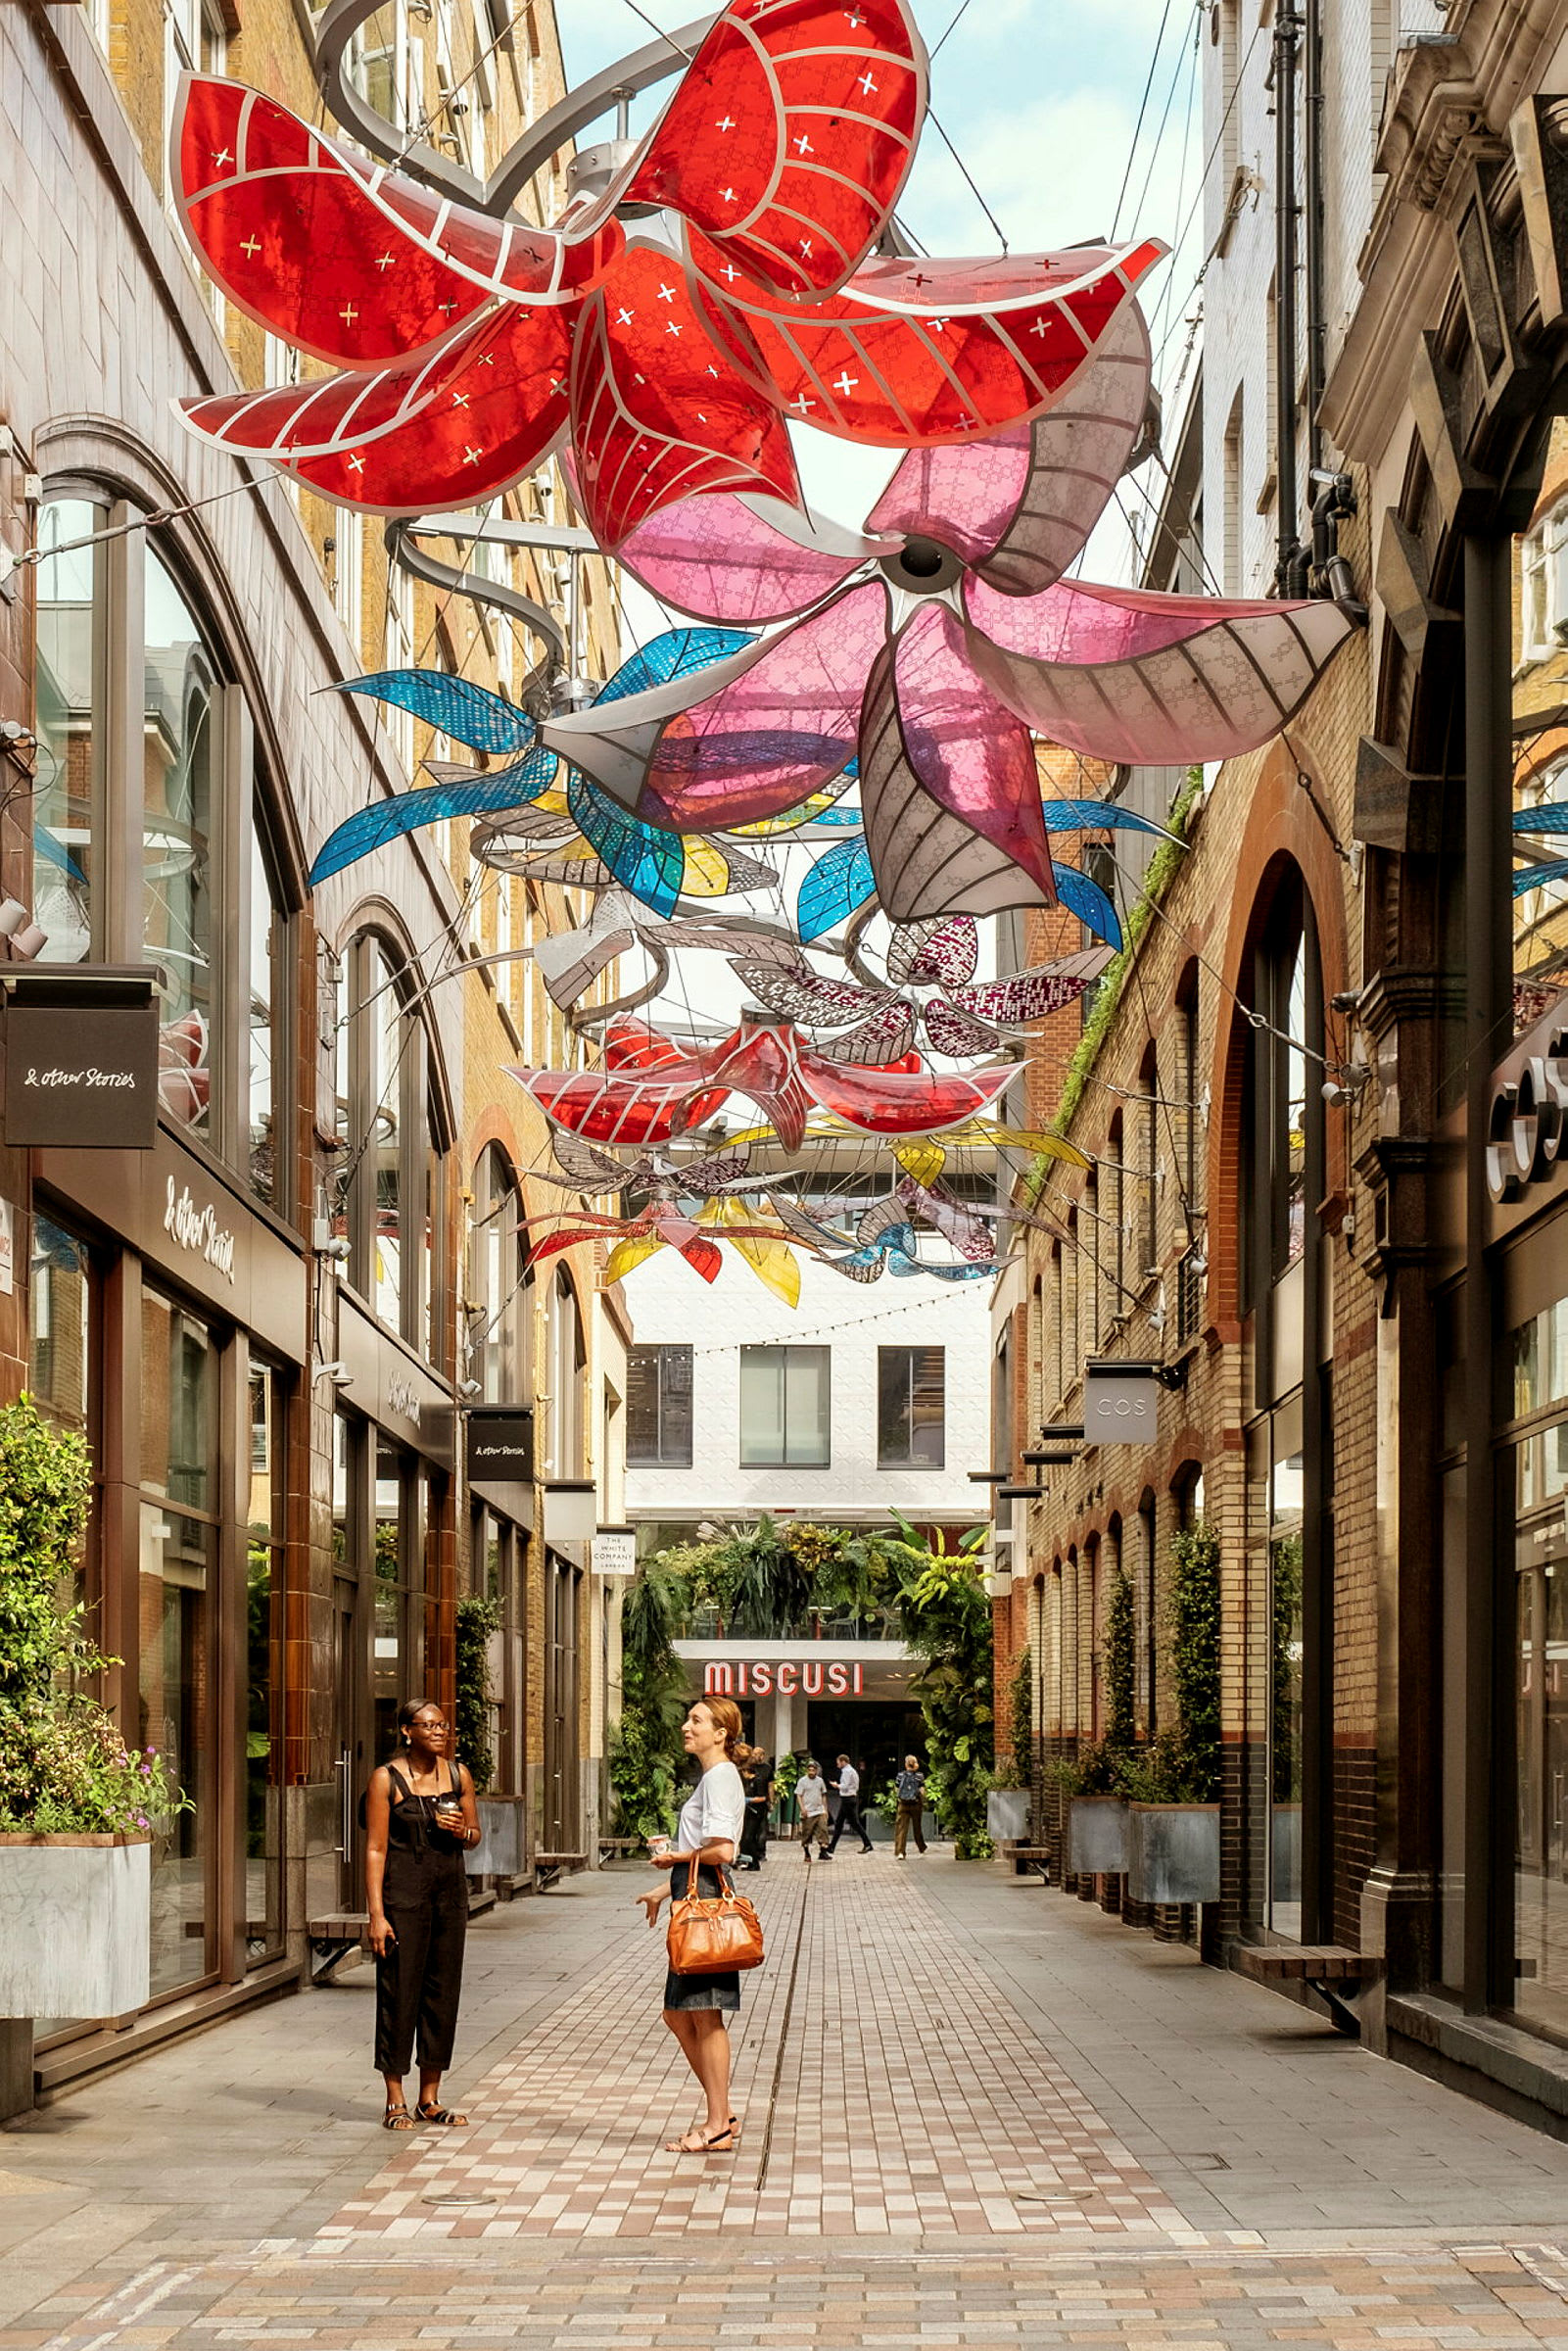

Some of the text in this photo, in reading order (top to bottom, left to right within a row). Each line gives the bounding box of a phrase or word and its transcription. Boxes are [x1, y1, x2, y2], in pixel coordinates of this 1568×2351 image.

[24, 1068, 135, 1088] & other Stories
[1096, 1398, 1147, 1416] COS
[704, 1661, 863, 1696] MISCUSI
